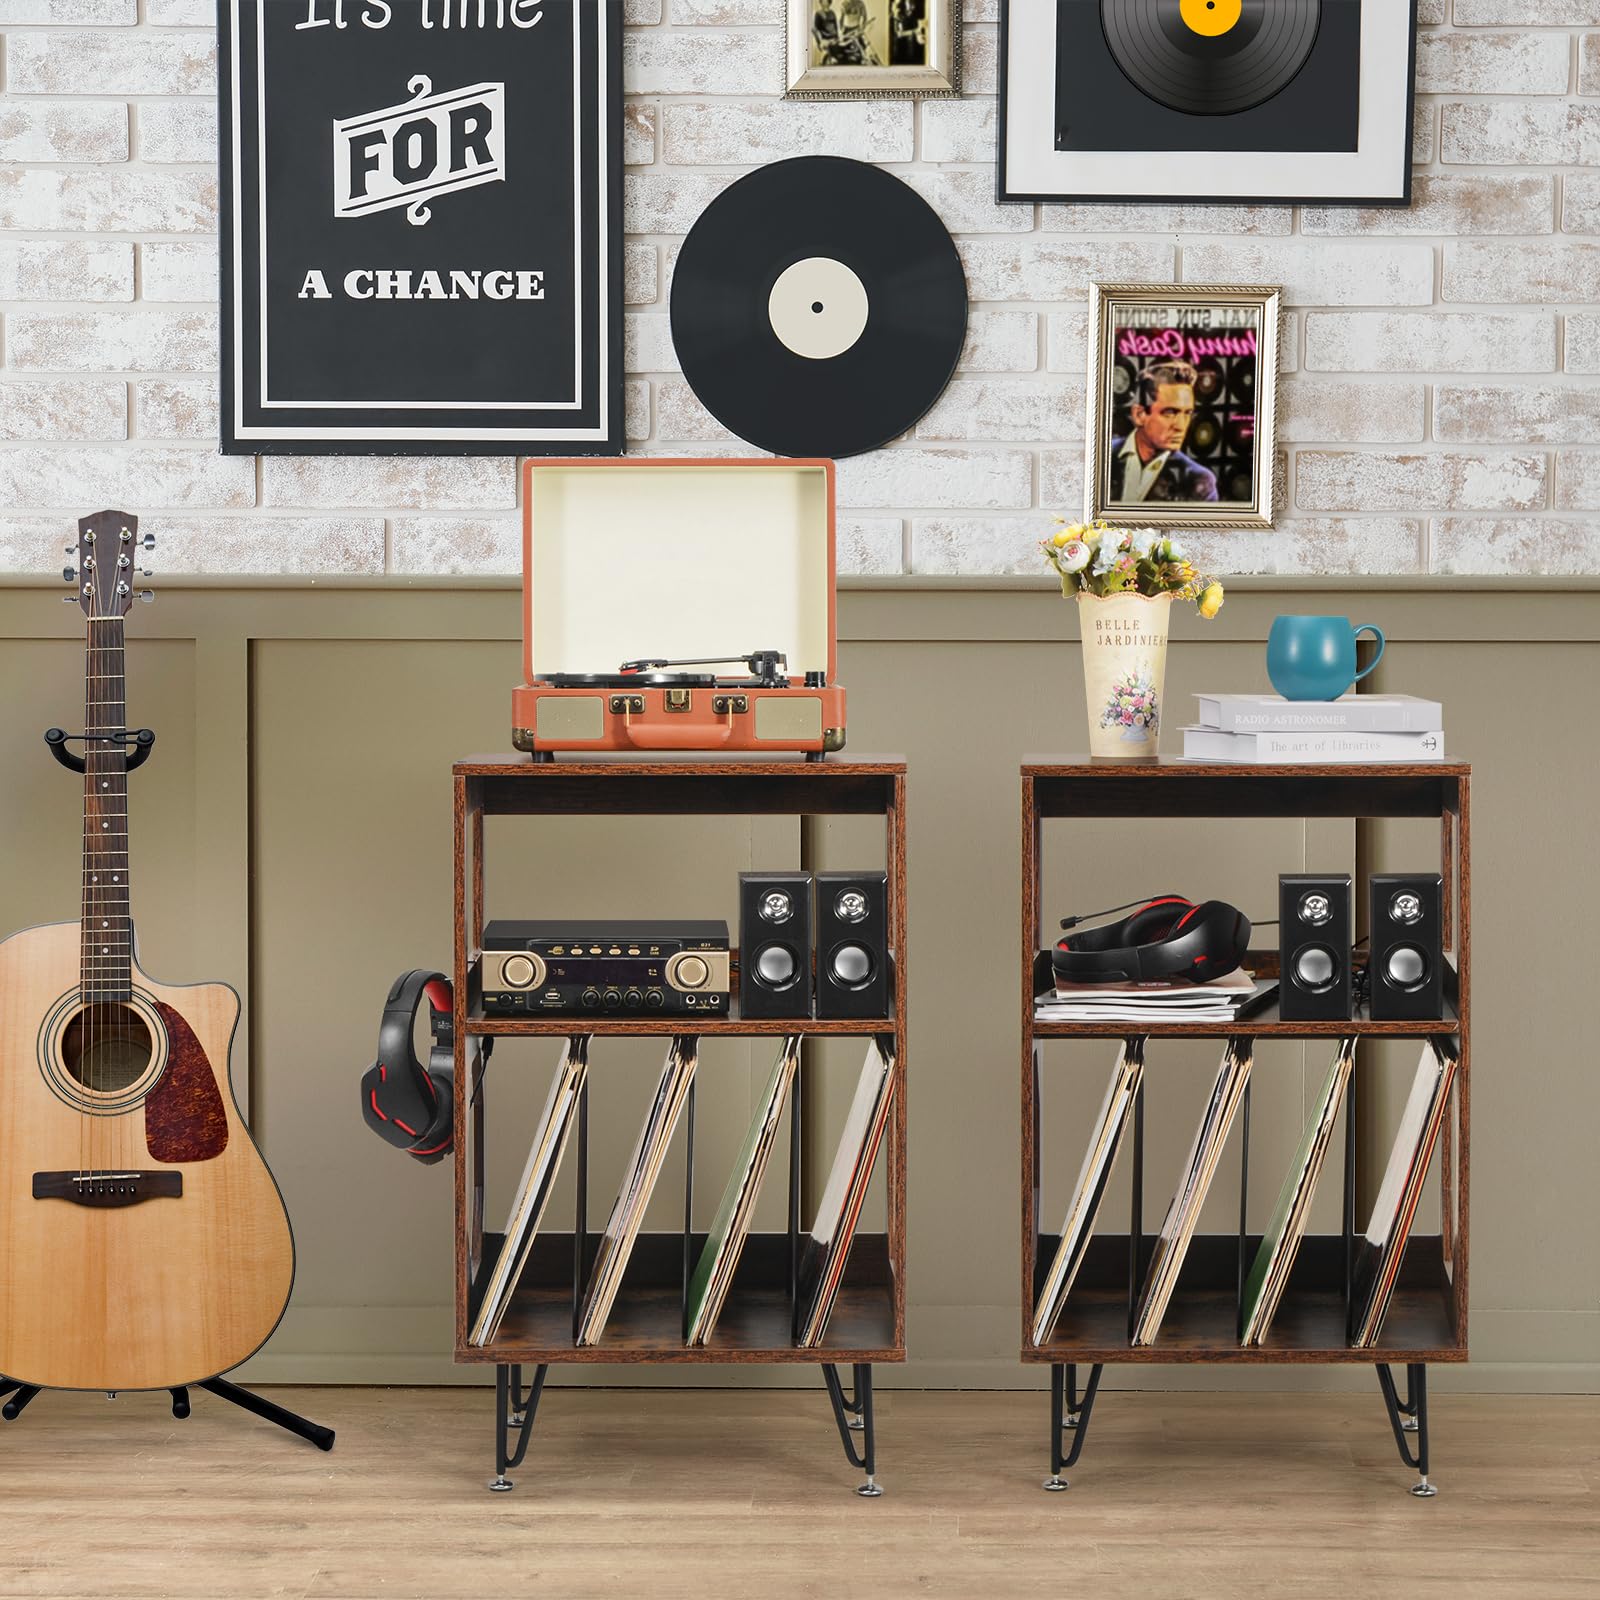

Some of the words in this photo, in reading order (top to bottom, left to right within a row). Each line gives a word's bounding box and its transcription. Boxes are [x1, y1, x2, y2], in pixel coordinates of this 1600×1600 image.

[295, 0, 392, 29] Its
[348, 102, 494, 200] FOR
[298, 270, 332, 298] A
[343, 270, 545, 299] CHANGE
[1095, 619, 1141, 631] BELLE
[1234, 714, 1269, 725] RADIO
[1273, 714, 1347, 725] ASTRONOMER
[1271, 741, 1288, 752] The
[1292, 742, 1309, 751] art
[1314, 740, 1328, 751] of
[1332, 739, 1382, 751] libraries
